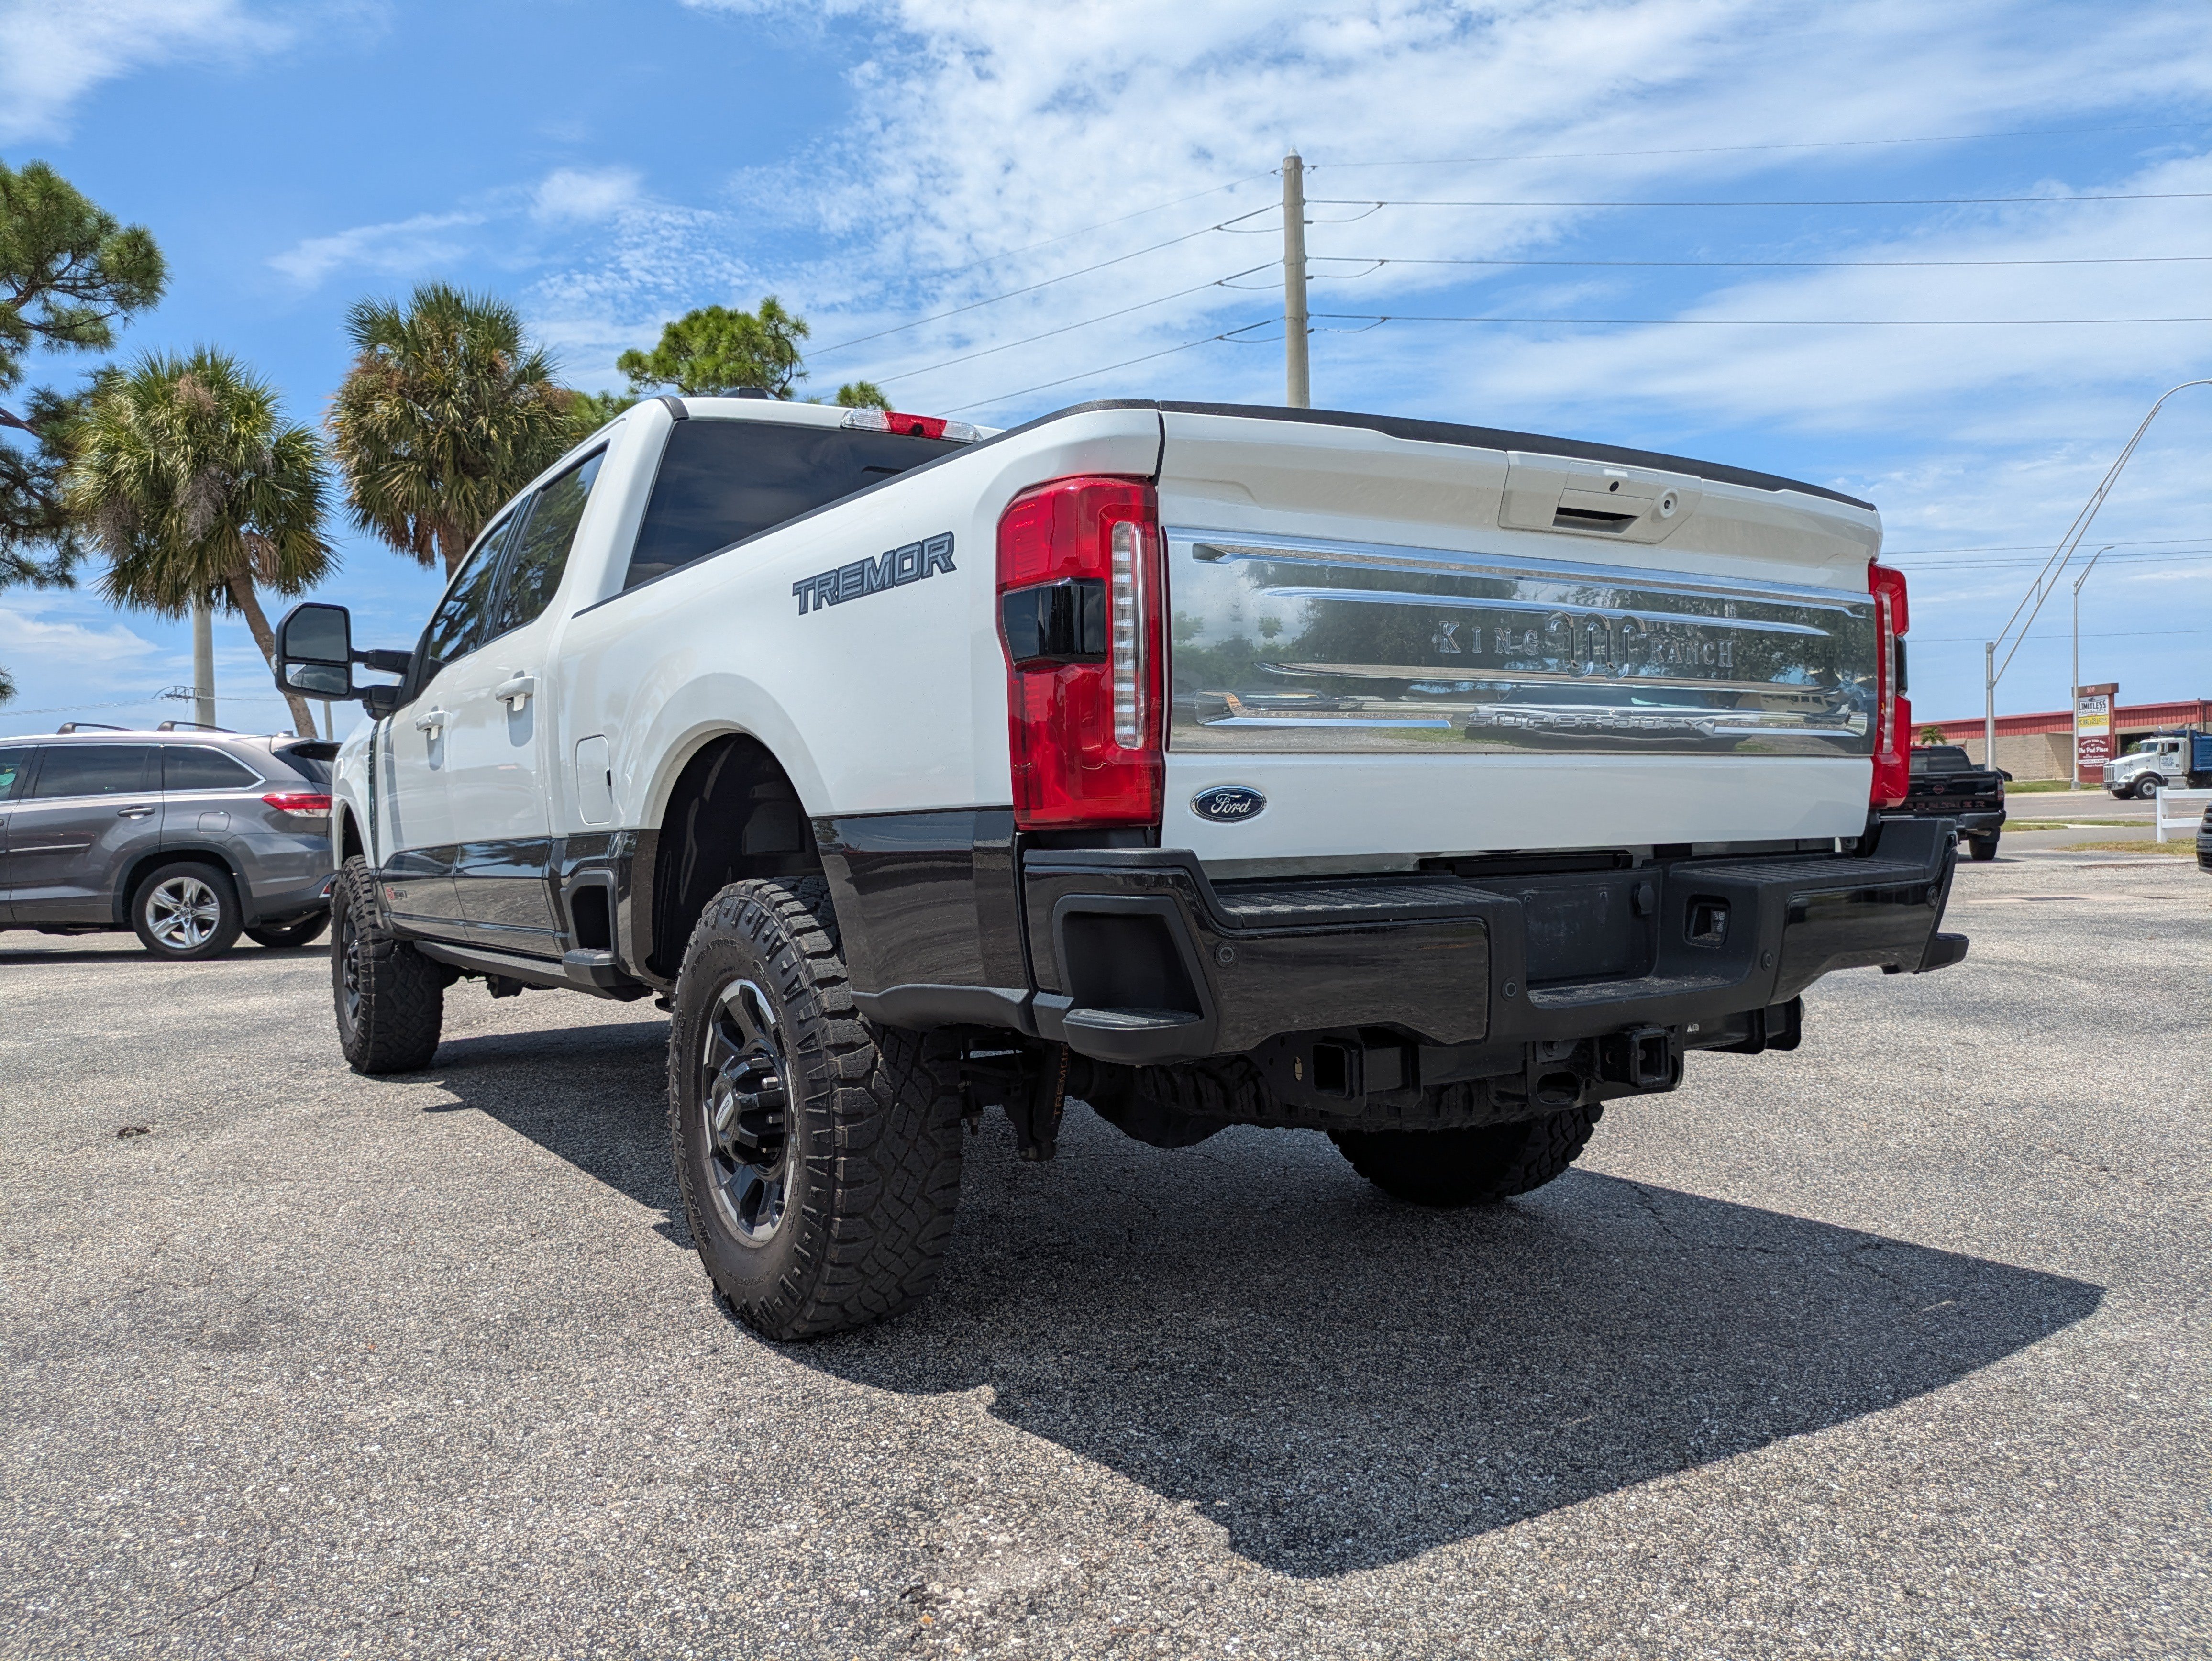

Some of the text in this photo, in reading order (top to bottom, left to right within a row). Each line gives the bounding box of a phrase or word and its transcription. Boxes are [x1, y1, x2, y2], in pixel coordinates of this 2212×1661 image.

[792, 531, 957, 616] TREMOR
[1438, 620, 1733, 667] KING RANCH
[1467, 713, 1704, 731] SUPER DUTY
[2078, 699, 2106, 710] LIMITLESS
[1210, 793, 1252, 814] Ford
[1053, 1044, 1069, 1119] TREMOR
[717, 1099, 730, 1124] FORD
[671, 1009, 711, 1251] WRANGLER
